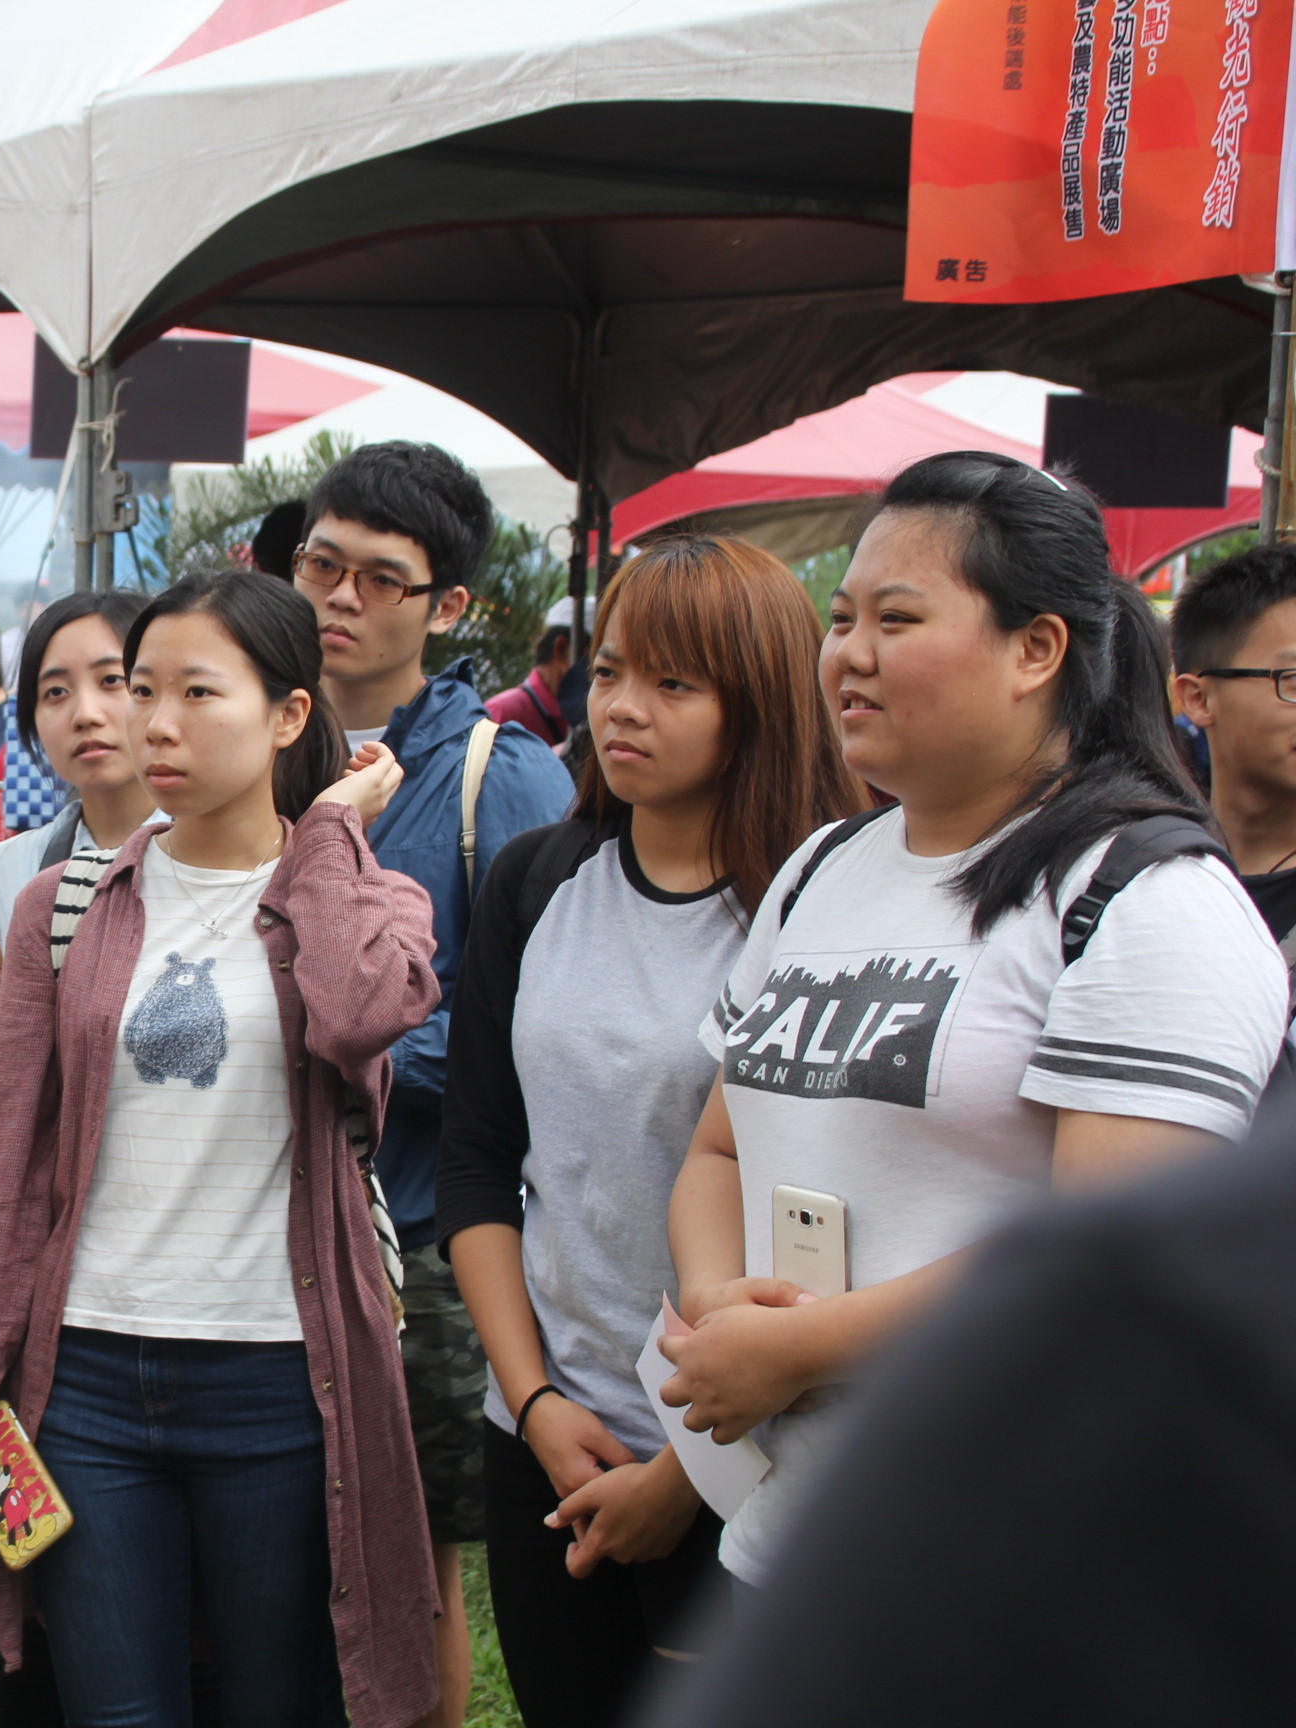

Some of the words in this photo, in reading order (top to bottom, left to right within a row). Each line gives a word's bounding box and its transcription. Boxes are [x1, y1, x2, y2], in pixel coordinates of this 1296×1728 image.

[1061, 0, 1096, 240] 及農特產品展售
[935, 258, 988, 282] 廣告
[725, 991, 926, 1064] CALIF
[737, 1058, 789, 1085] SAN
[804, 1067, 849, 1090] DIEGO
